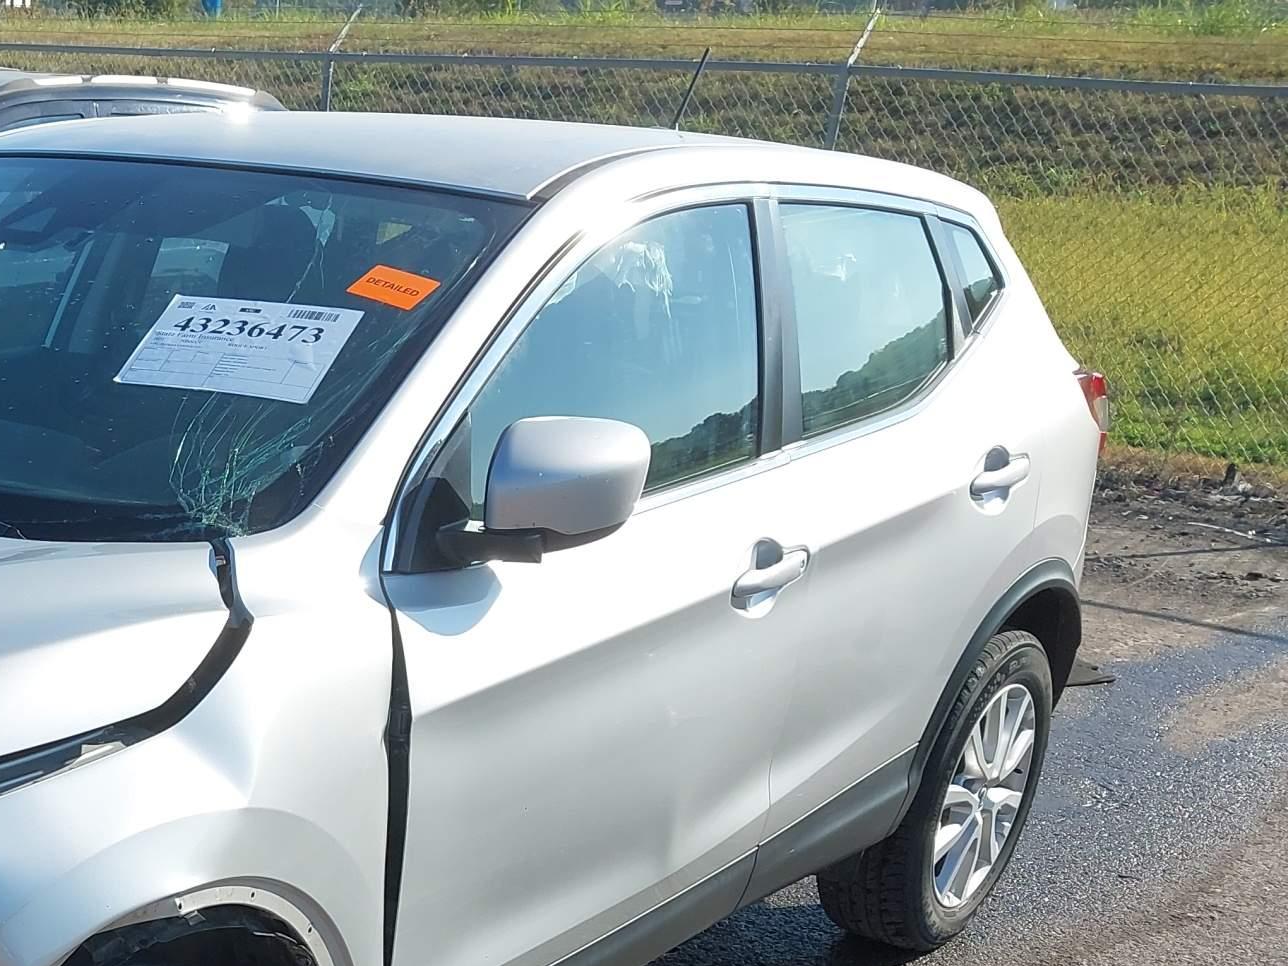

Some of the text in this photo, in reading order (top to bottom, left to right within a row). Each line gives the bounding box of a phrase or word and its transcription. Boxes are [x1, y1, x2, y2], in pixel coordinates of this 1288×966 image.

[366, 276, 420, 297] DETAILED
[173, 316, 325, 344] 43236473
[198, 333, 233, 342] Insurance
